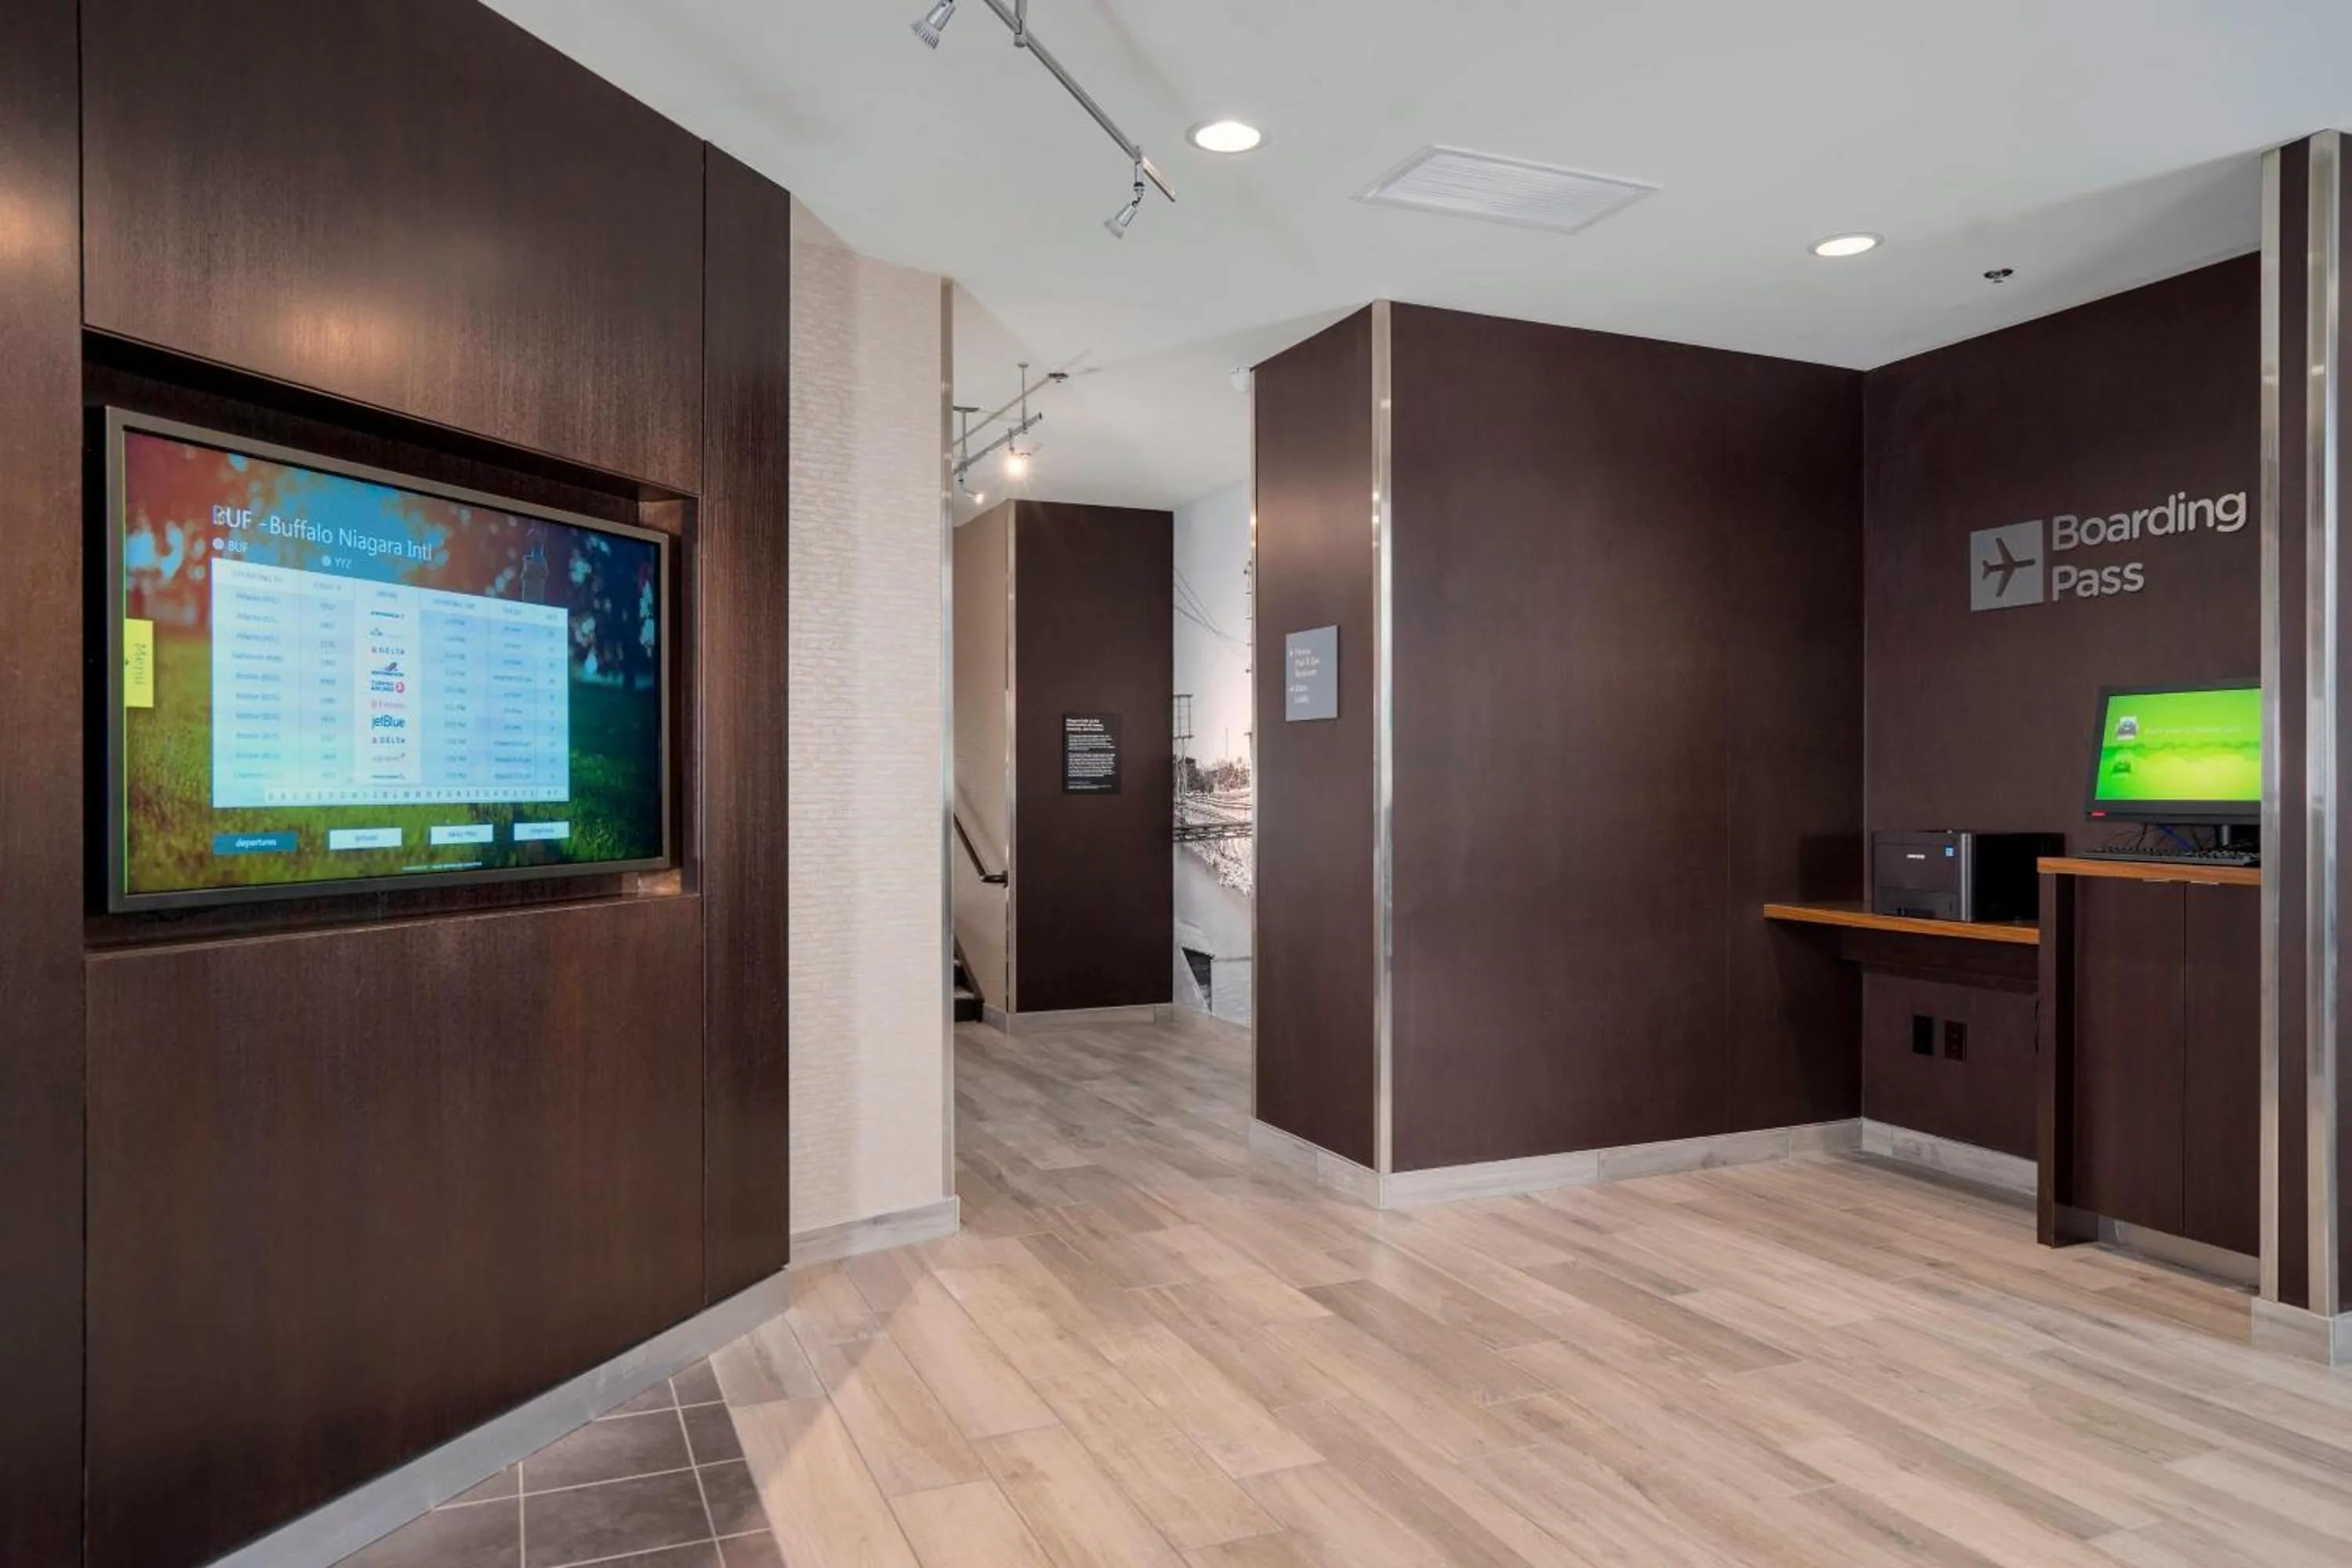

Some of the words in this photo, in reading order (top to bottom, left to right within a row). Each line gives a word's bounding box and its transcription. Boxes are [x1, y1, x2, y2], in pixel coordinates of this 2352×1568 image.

[212, 504, 252, 529] BUF
[339, 528, 402, 555] Niagara
[407, 539, 433, 561] Intl
[2051, 492, 2246, 551] Boarding
[228, 539, 249, 553] BUF
[2051, 562, 2144, 602] Pass
[371, 711, 406, 729] jetBlue
